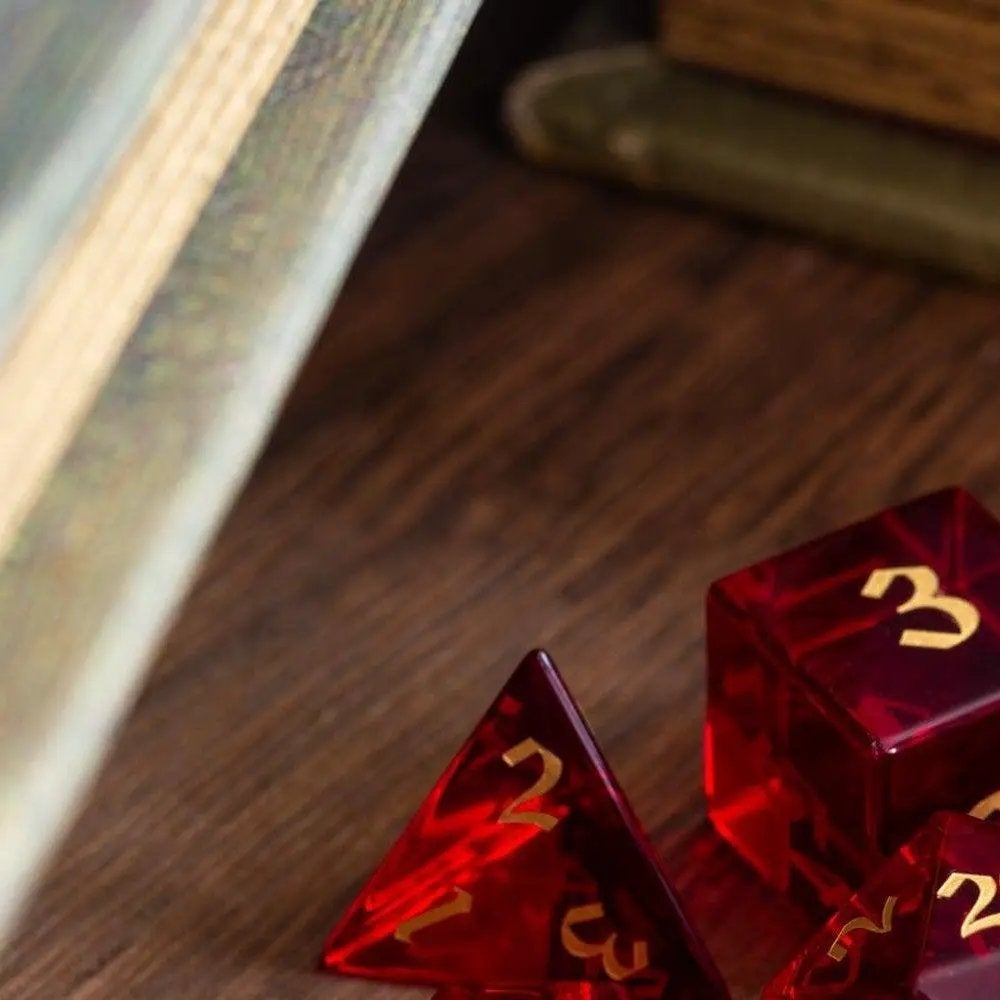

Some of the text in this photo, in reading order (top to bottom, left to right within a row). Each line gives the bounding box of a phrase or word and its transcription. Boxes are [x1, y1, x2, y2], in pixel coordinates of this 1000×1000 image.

[860, 565, 980, 650] 3
[498, 738, 563, 832] 2
[394, 886, 473, 945] 1
[561, 903, 649, 982] 3
